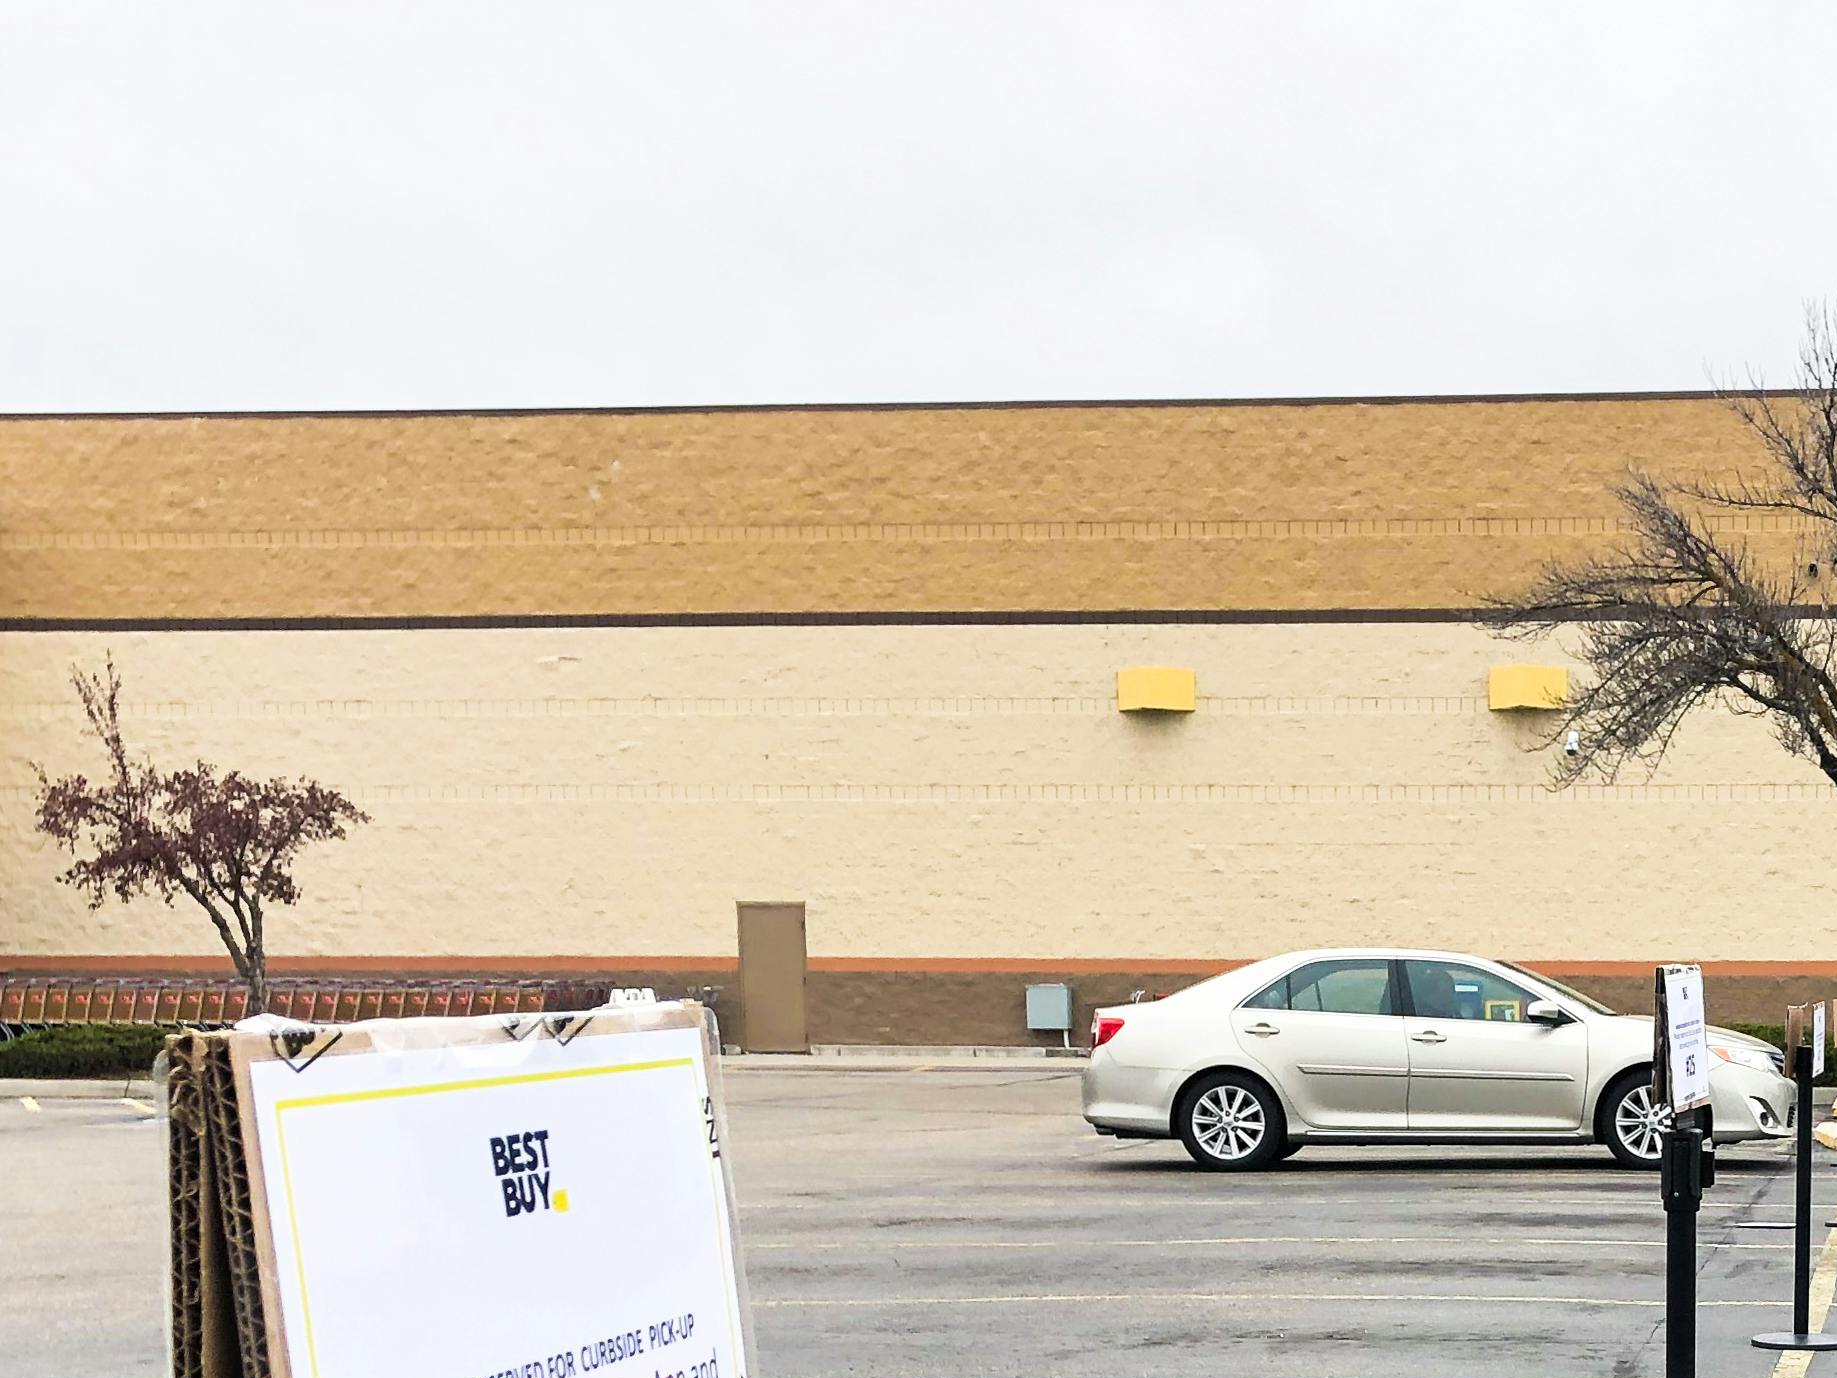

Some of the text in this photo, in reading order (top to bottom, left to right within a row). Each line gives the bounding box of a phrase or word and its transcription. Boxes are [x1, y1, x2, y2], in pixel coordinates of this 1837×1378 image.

[489, 1130, 549, 1176] BEST
[501, 1171, 550, 1217] BUY
[581, 1329, 645, 1373] CURBSIDE
[649, 1312, 695, 1350] PICK-UP
